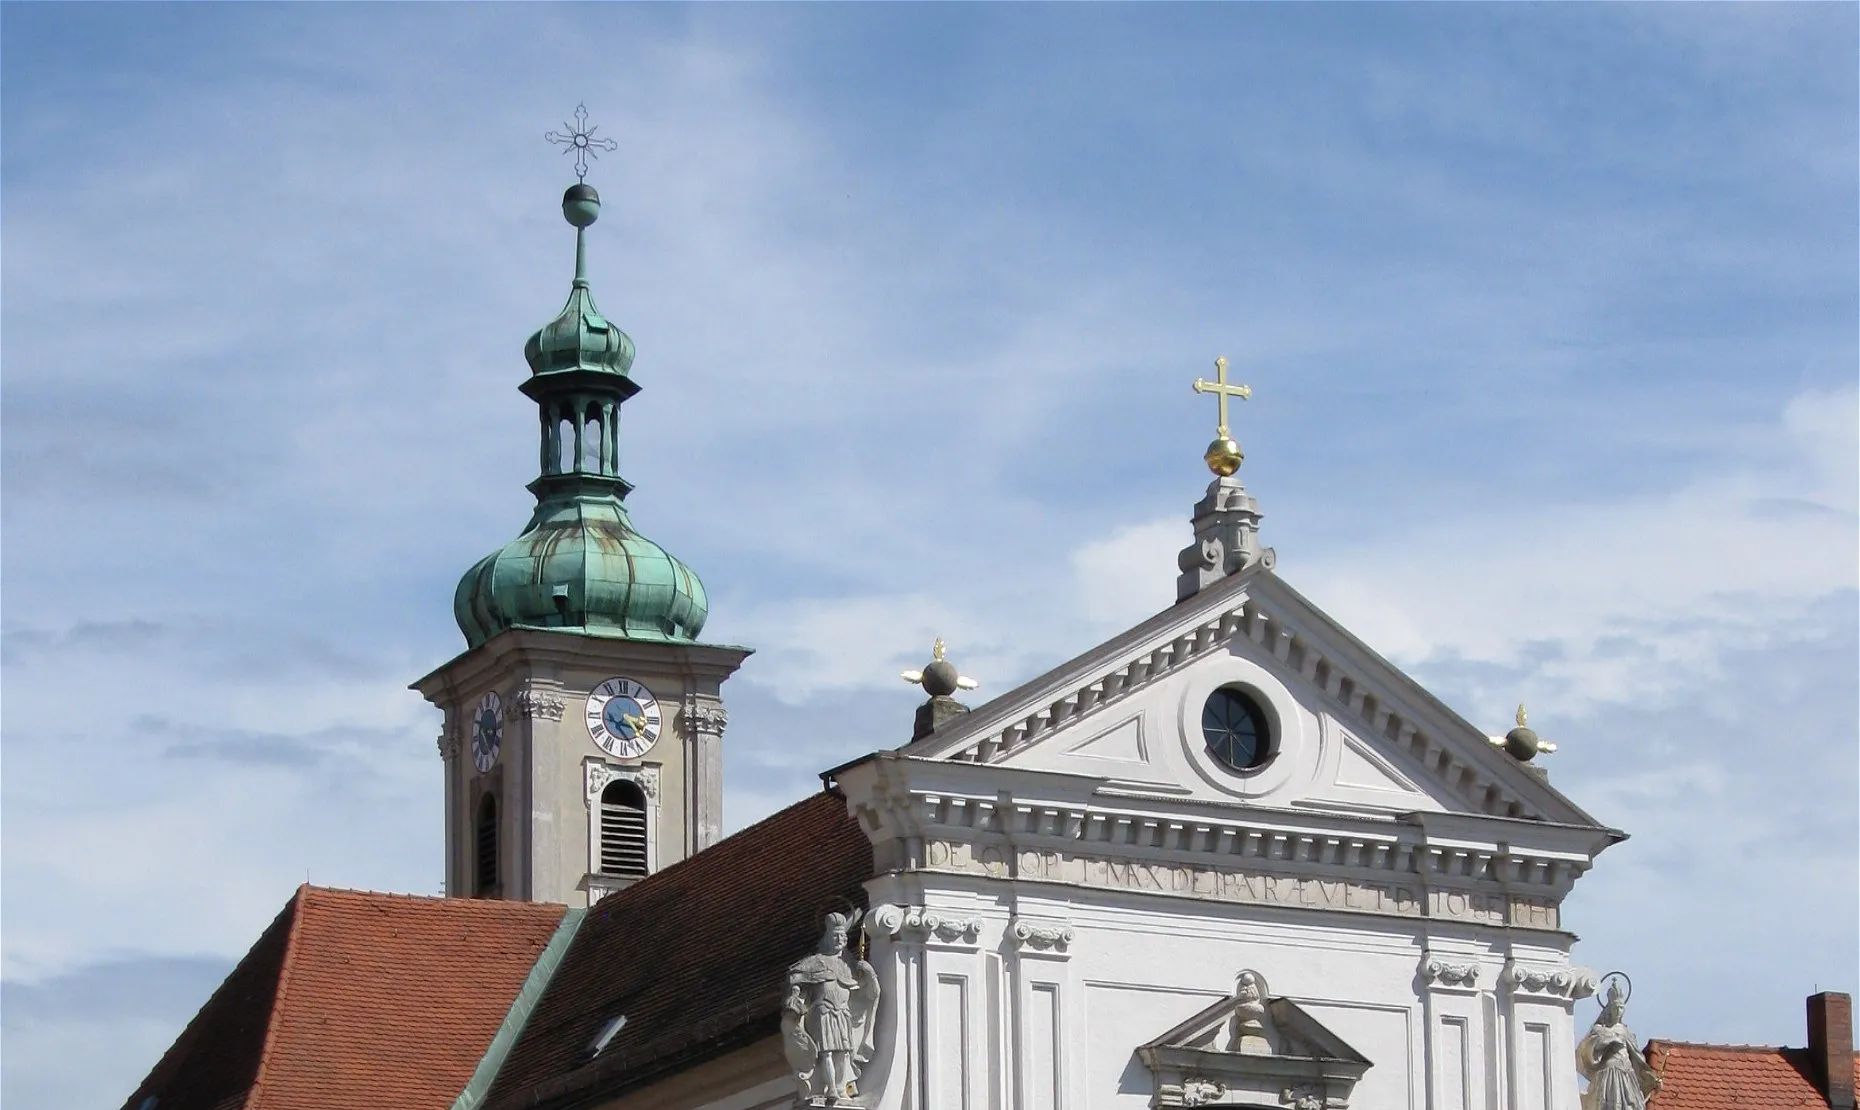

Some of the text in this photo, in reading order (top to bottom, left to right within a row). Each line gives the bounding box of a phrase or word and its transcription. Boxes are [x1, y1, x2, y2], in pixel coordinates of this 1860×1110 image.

[618, 680, 629, 694] XII
[634, 687, 642, 698] I
[643, 699, 655, 710] II
[647, 716, 659, 725] III
